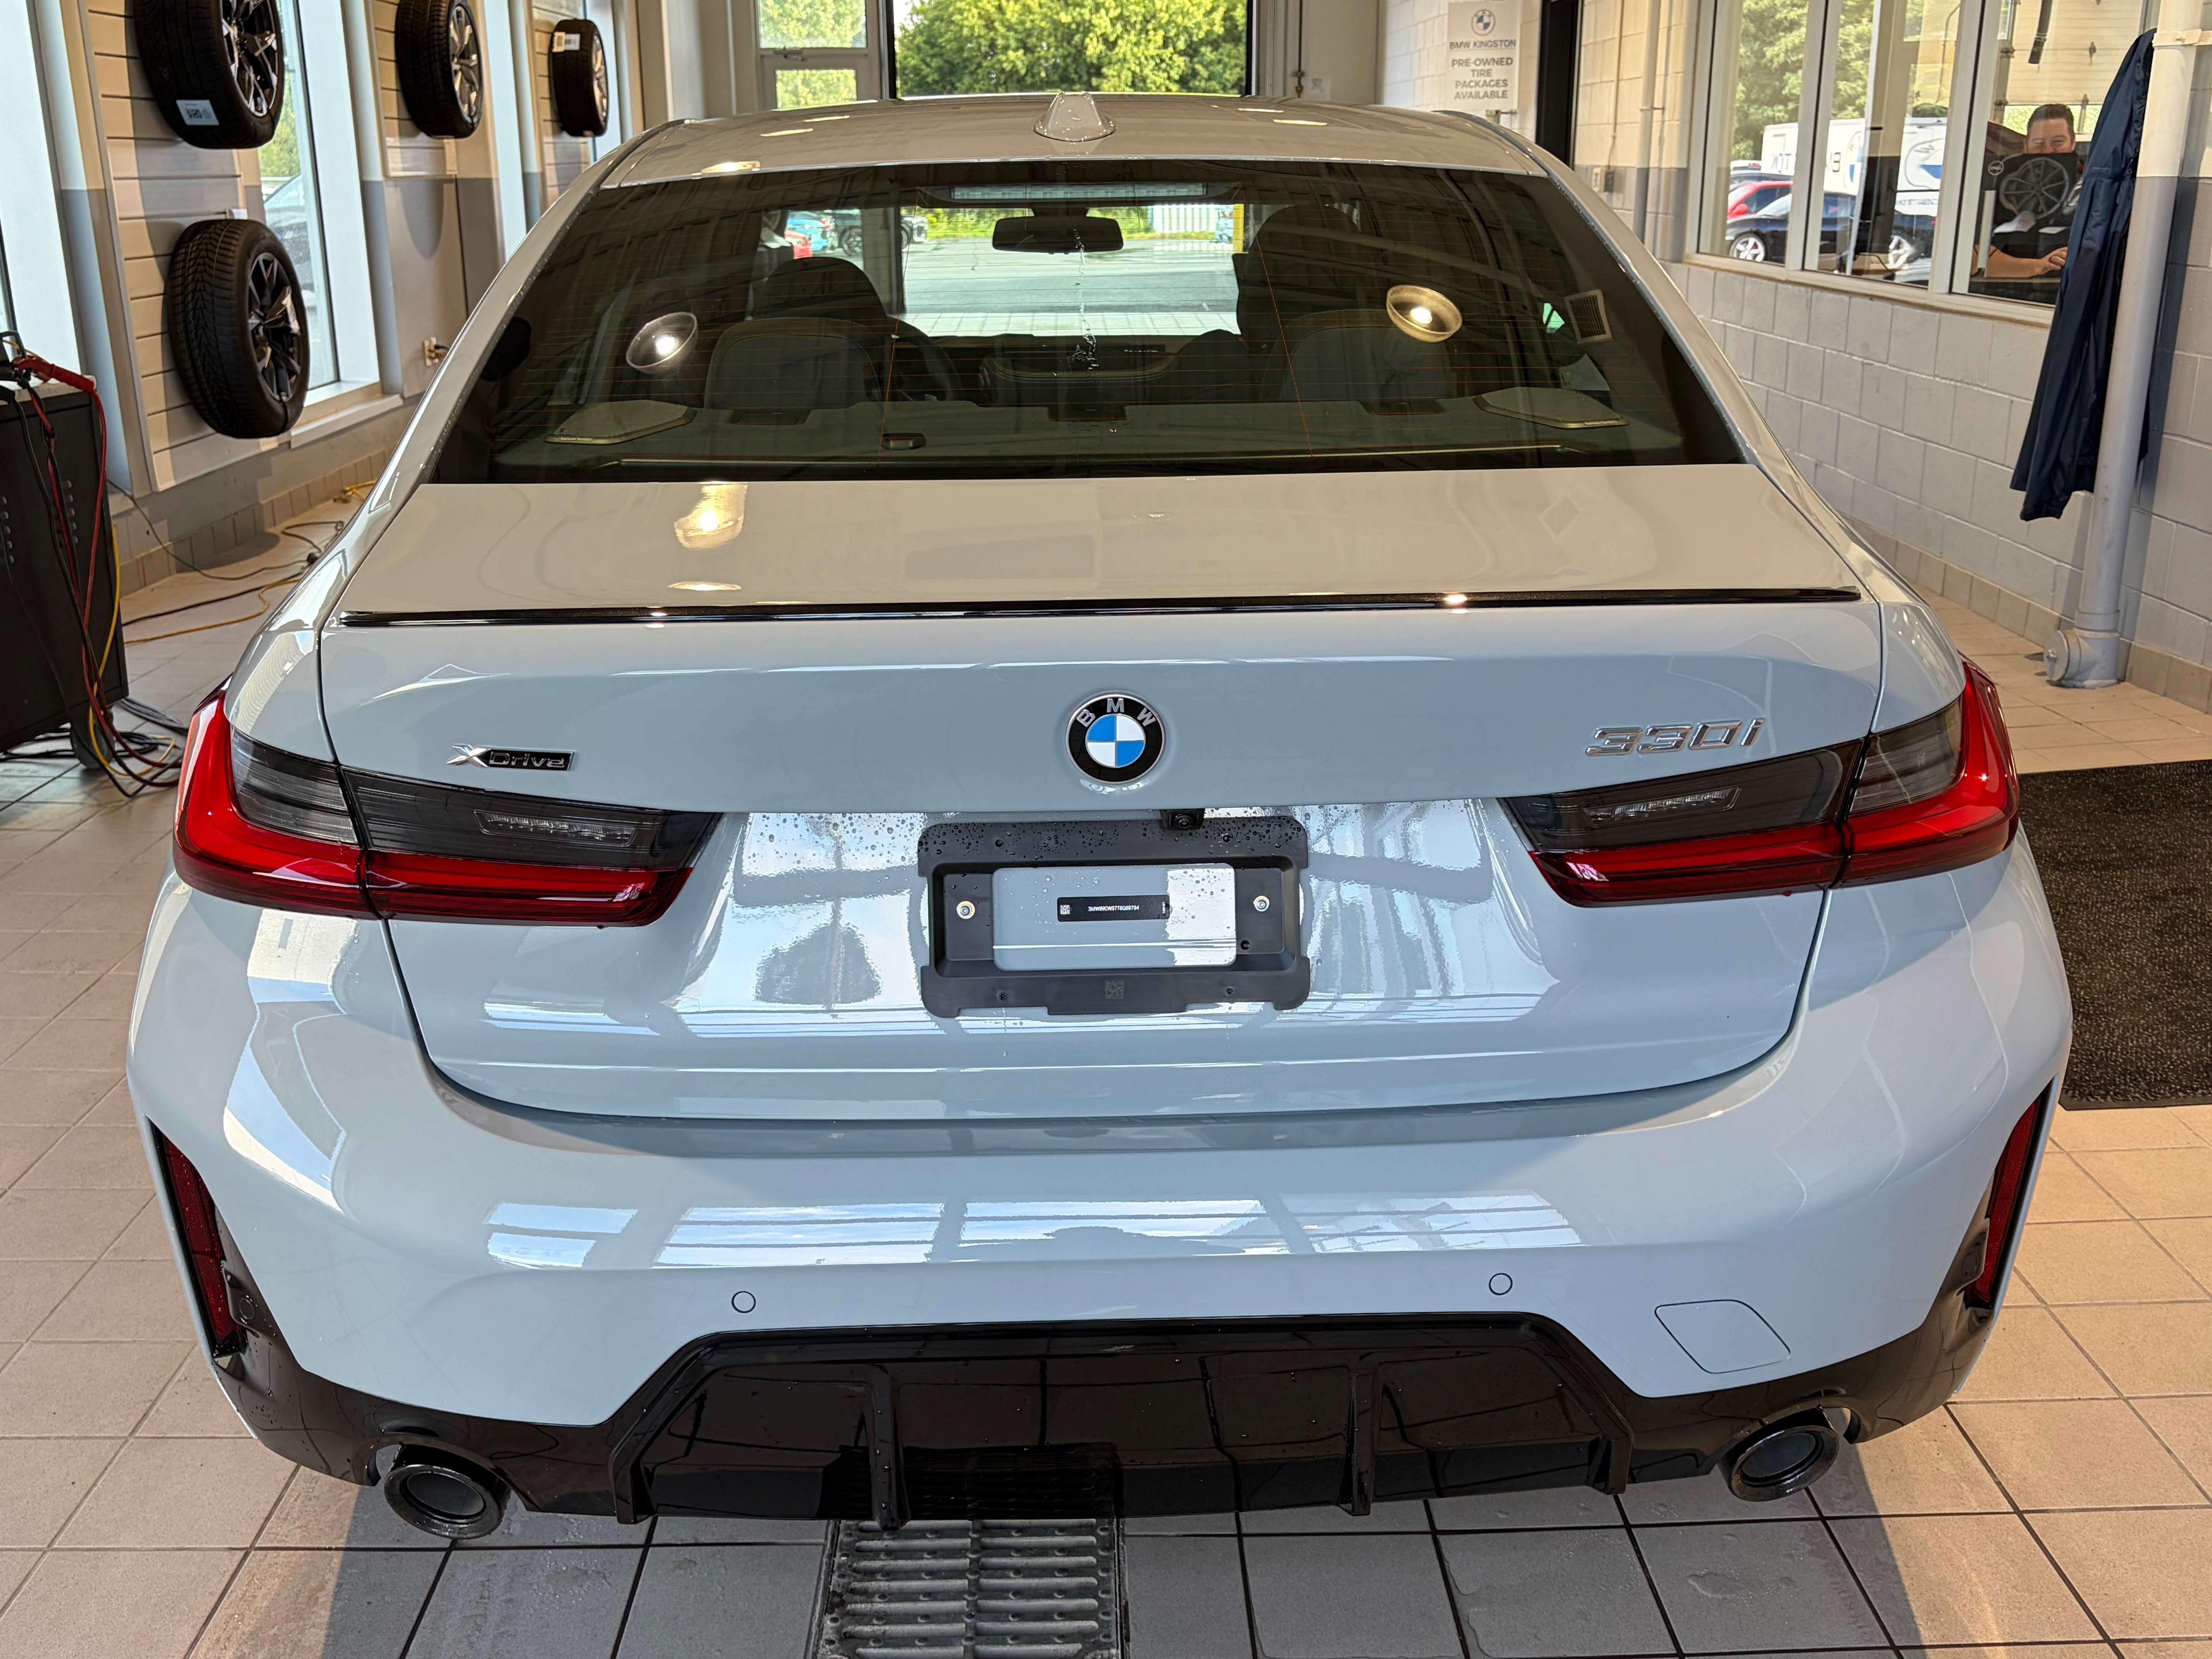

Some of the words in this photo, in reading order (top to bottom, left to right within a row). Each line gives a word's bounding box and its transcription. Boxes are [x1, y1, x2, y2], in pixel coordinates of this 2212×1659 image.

[1449, 41, 1471, 49] BMW
[1473, 39, 1516, 48] KINGSTON
[1452, 57, 1513, 67] PRE-OWNED
[1471, 69, 1492, 77] TIRE
[1455, 79, 1508, 89] PACKAGES
[1454, 90, 1508, 100] AVAILABLE
[1076, 698, 1156, 728] BMW
[1586, 717, 1766, 756] 330i
